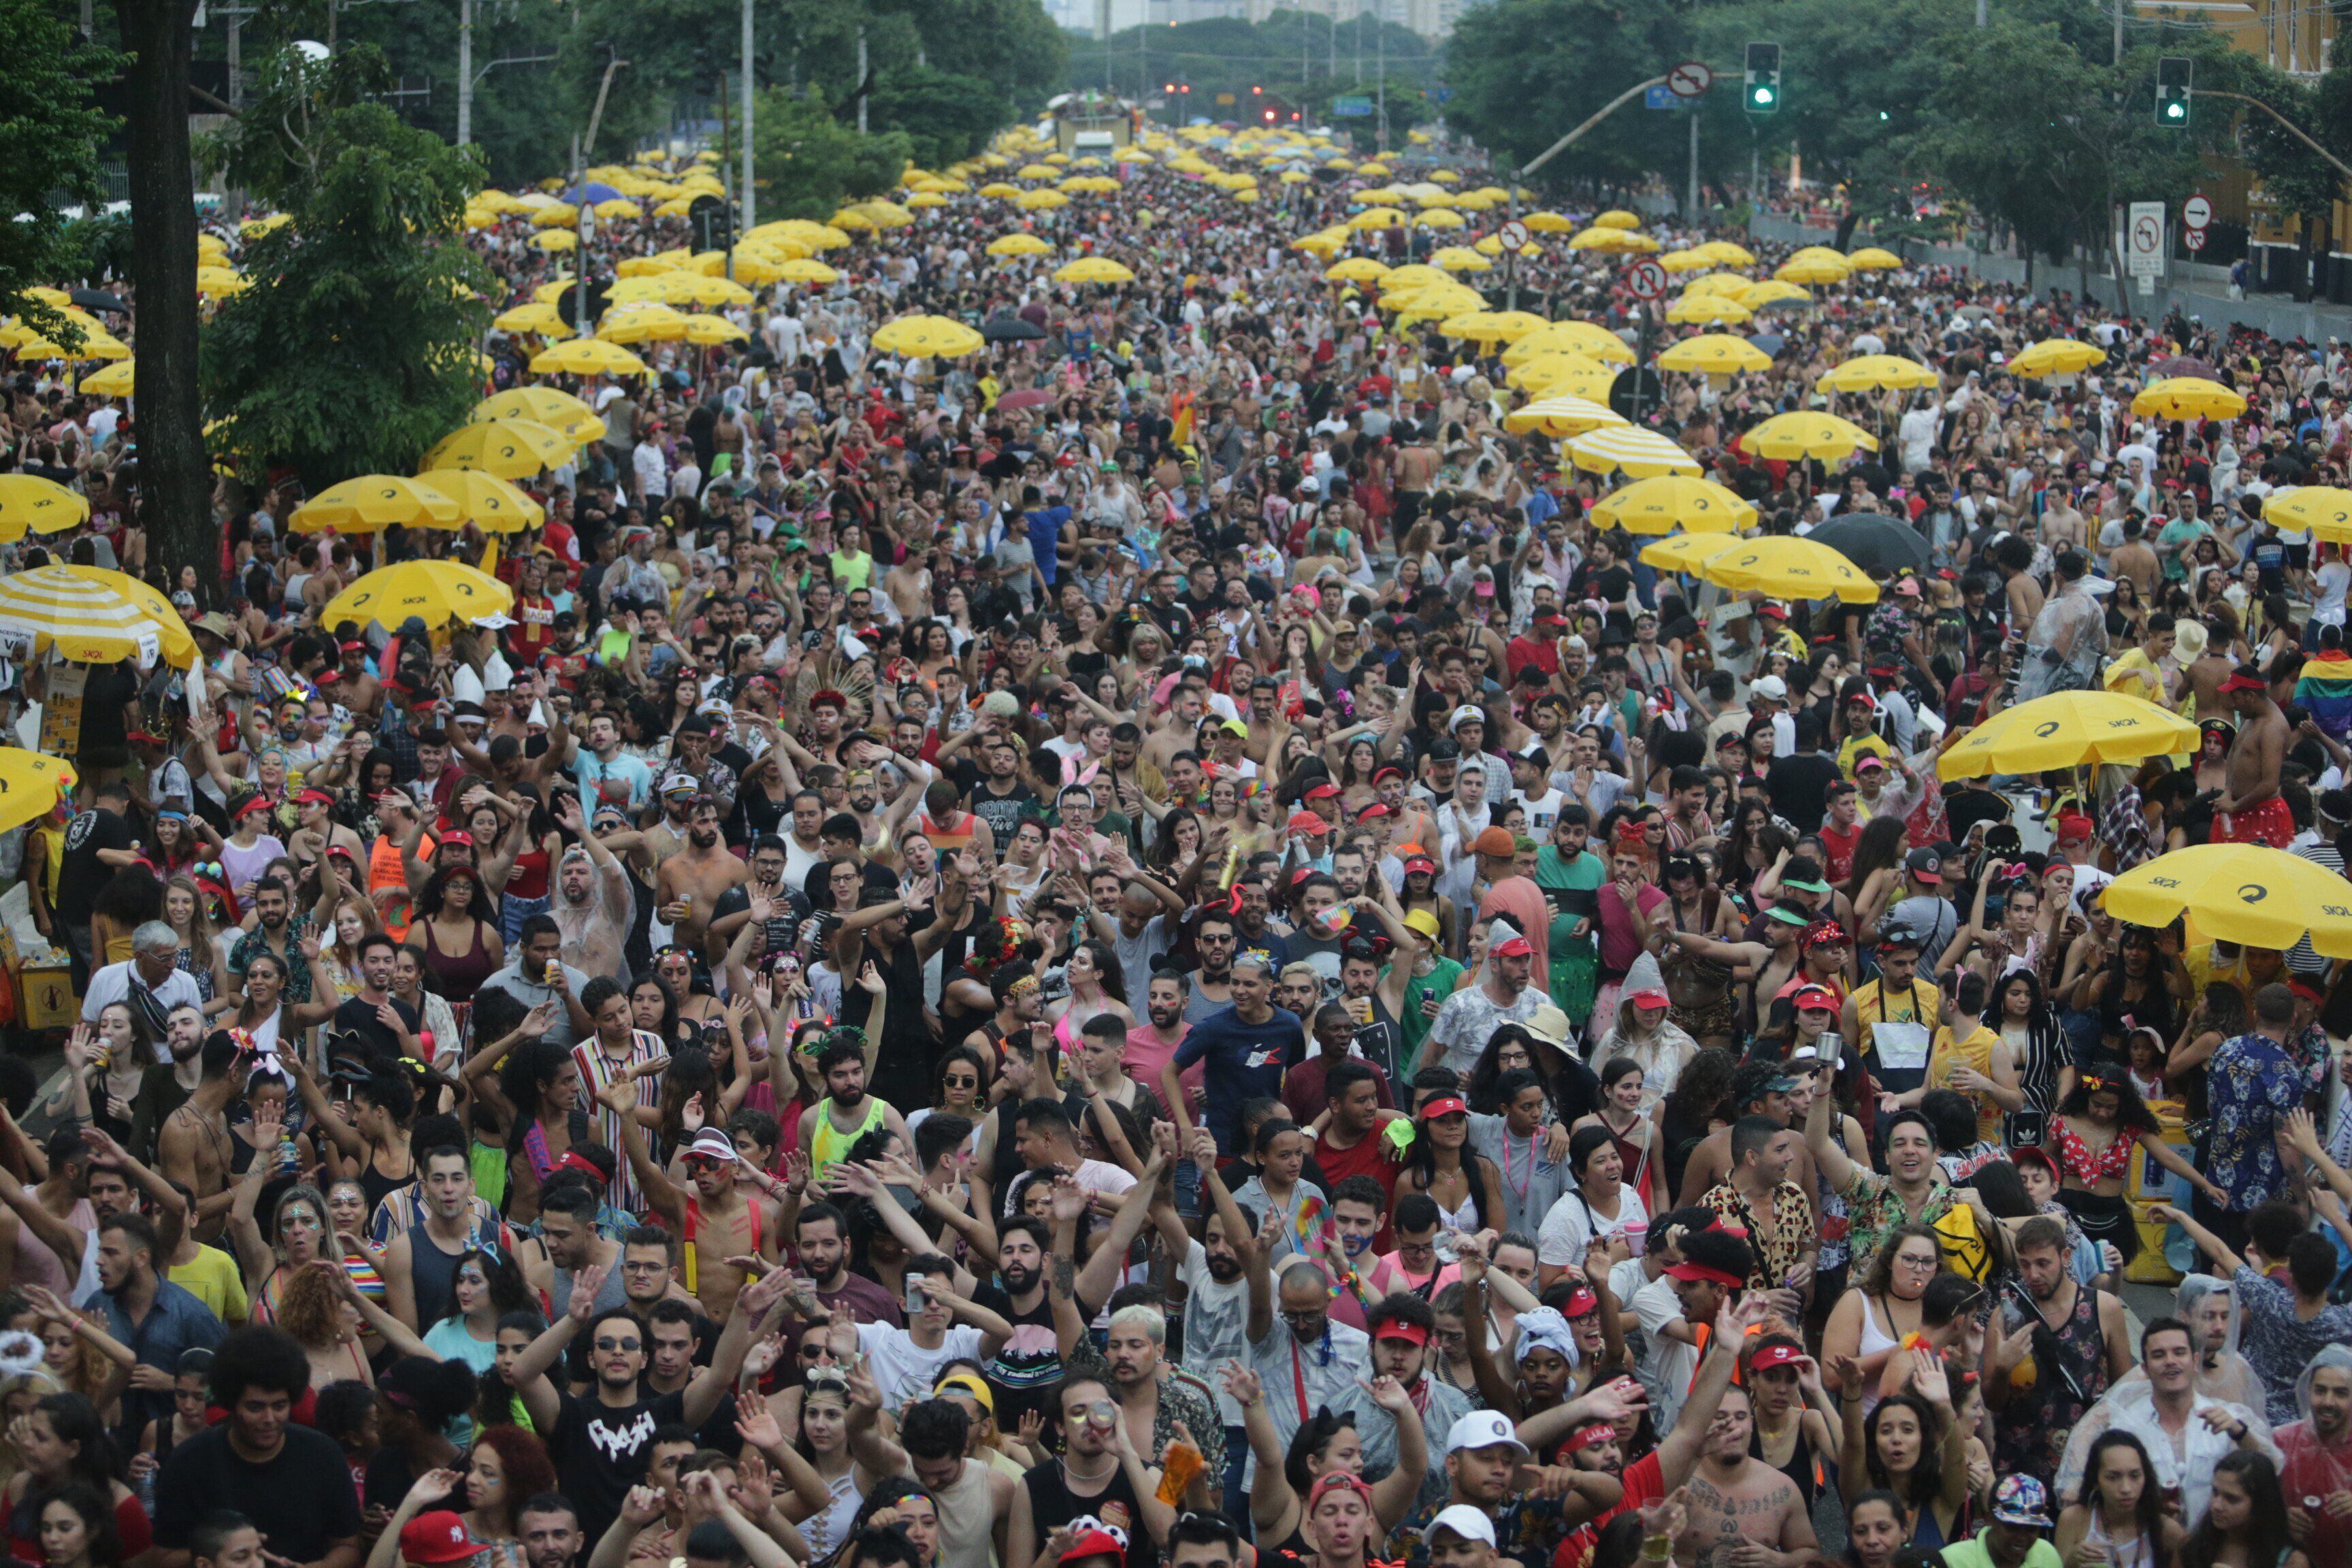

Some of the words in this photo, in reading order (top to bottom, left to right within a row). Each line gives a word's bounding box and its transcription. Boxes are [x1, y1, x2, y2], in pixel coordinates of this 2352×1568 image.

[33, 498, 54, 508] SKOL
[402, 596, 428, 605] SKOL
[82, 649, 103, 659] SKOL
[2108, 718, 2140, 728] SKOL
[2149, 877, 2182, 888] SKOL
[2322, 904, 2352, 917] SKOL
